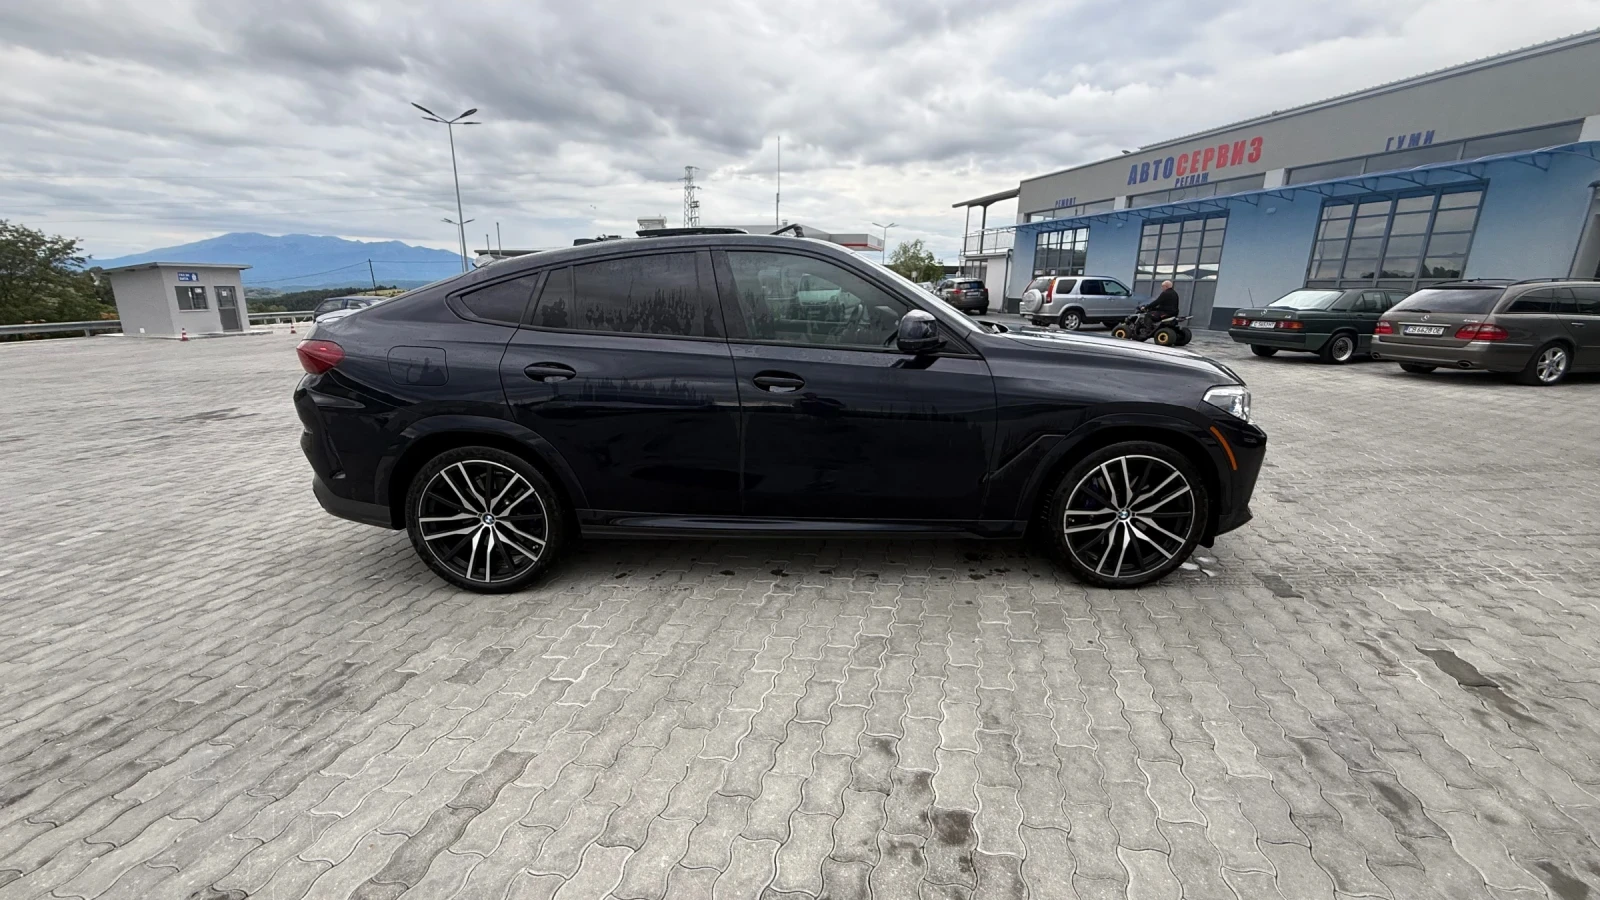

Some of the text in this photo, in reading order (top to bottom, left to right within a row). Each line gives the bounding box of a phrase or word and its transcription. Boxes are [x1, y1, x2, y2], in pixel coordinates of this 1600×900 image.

[1385, 129, 1436, 152] ГУМИ
[1127, 136, 1264, 186] АВТОСЕРВИЗ
[1175, 172, 1210, 188] РЕГЛАЖ
